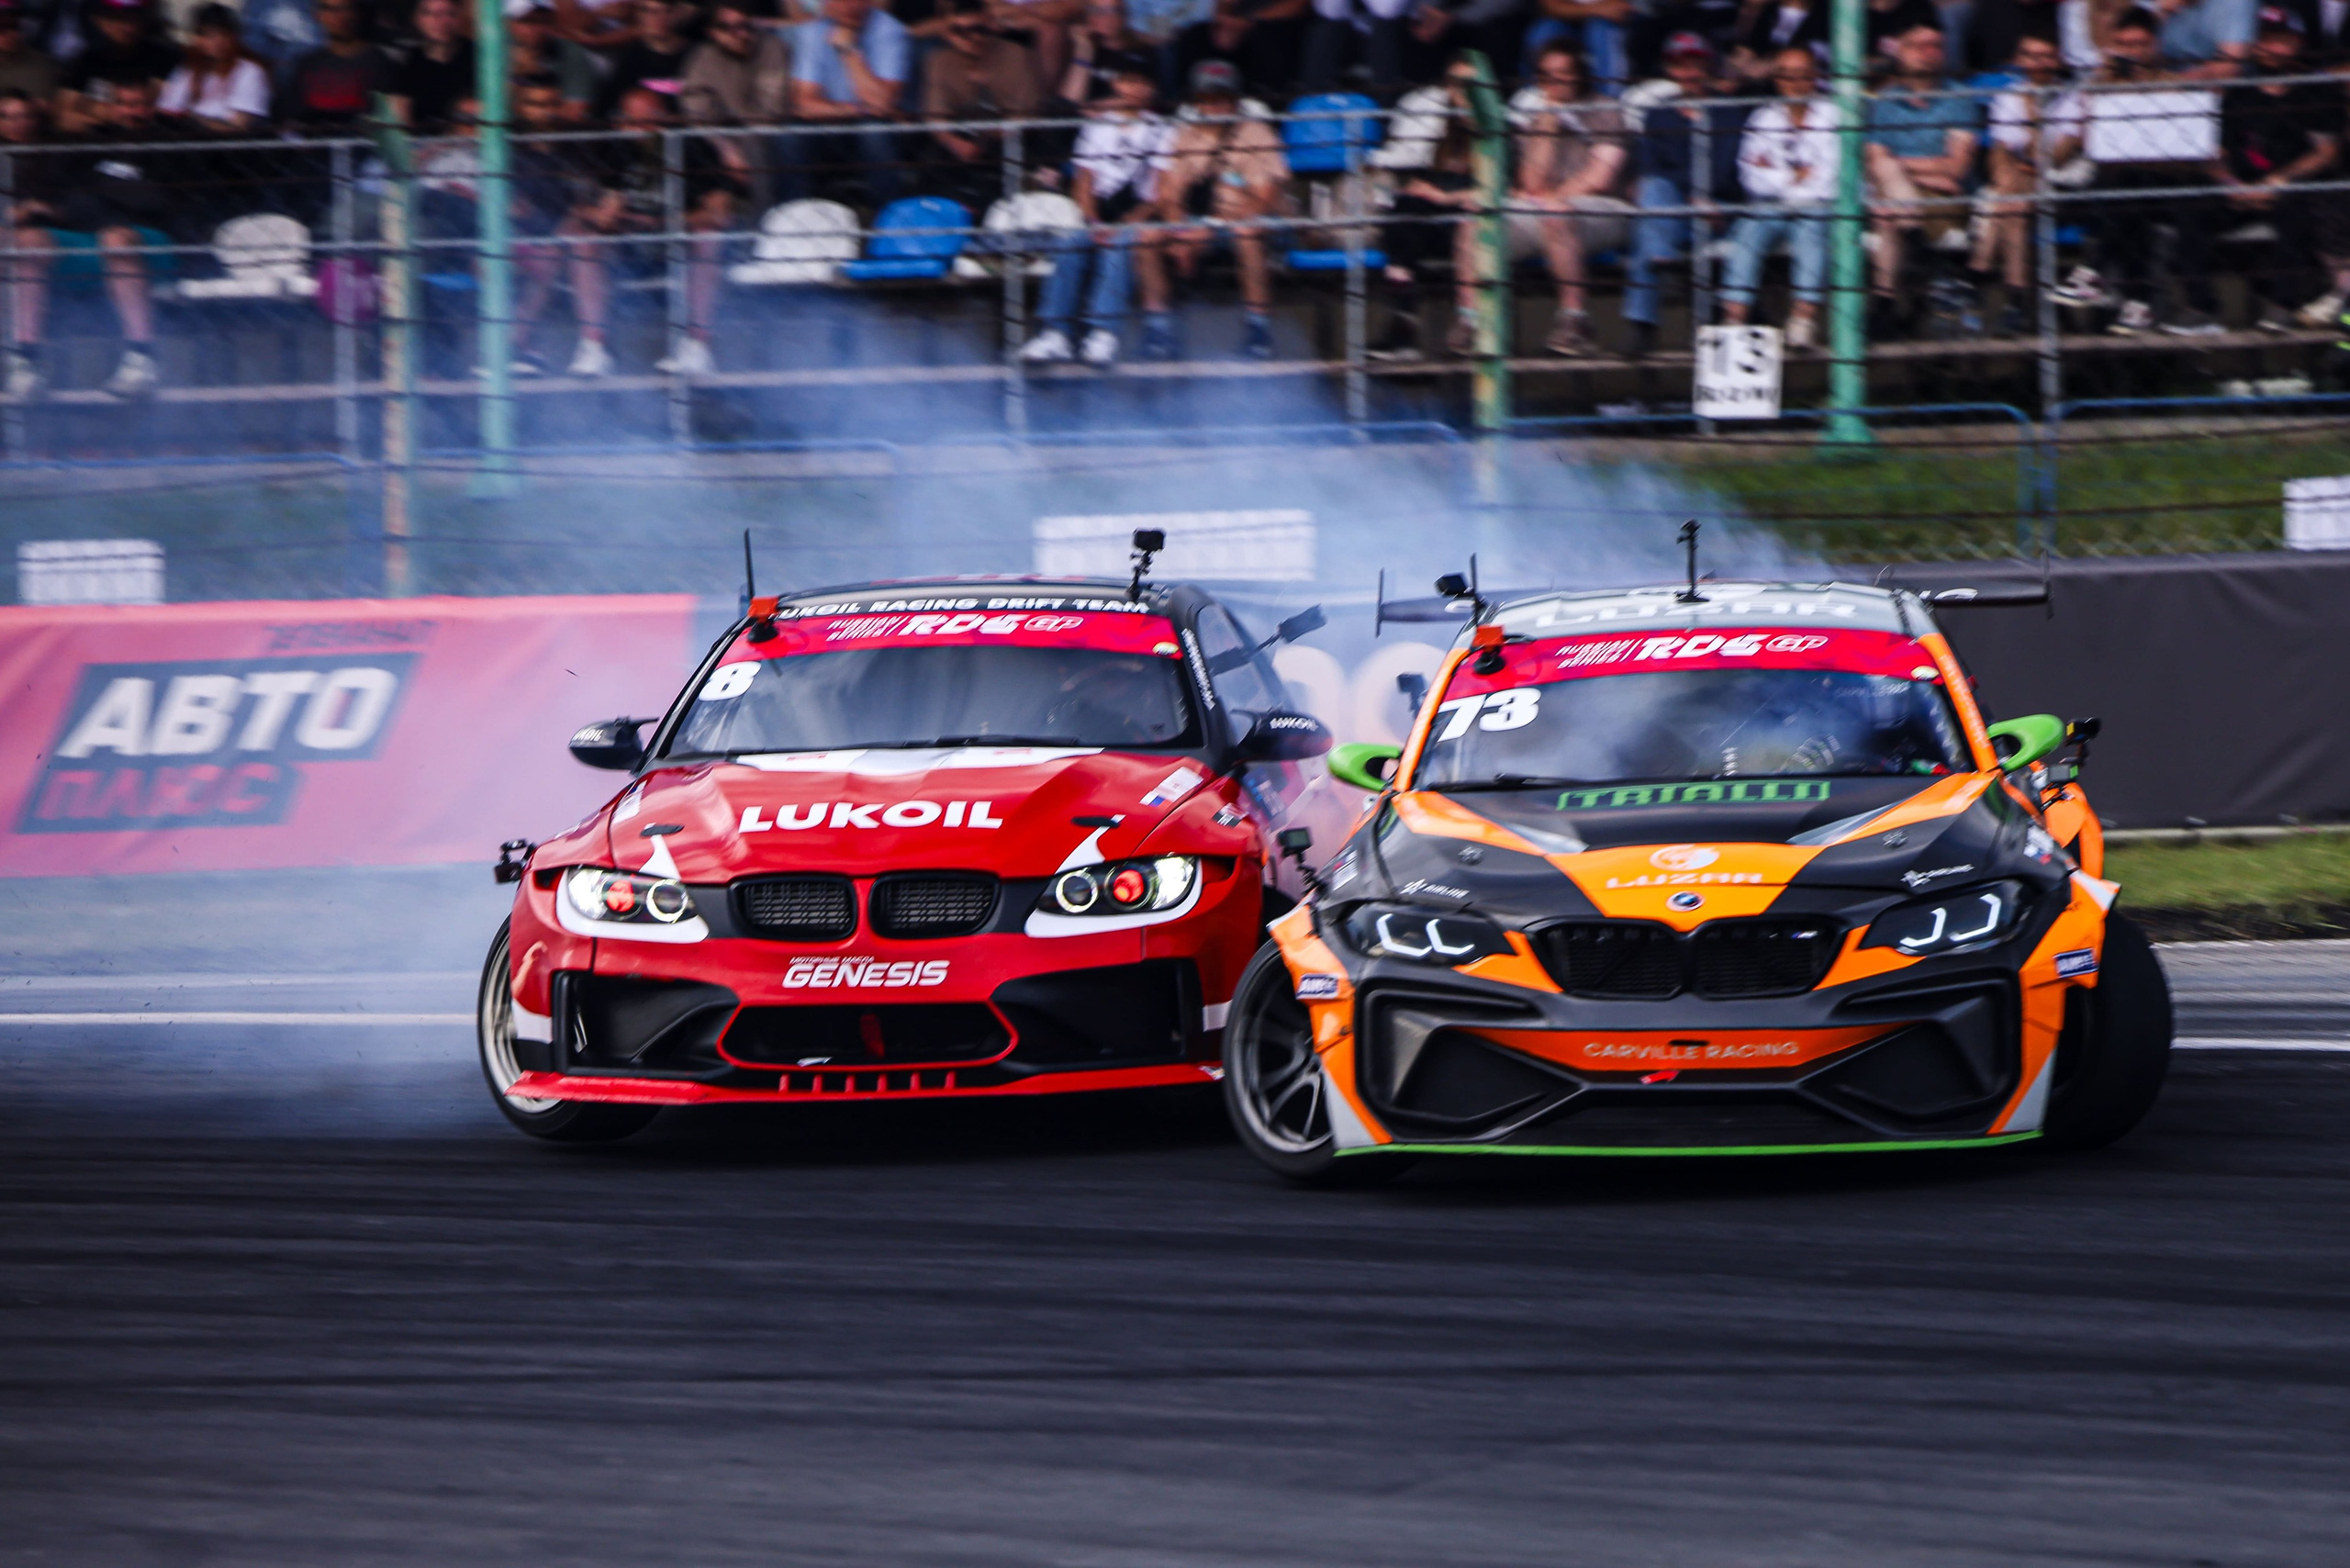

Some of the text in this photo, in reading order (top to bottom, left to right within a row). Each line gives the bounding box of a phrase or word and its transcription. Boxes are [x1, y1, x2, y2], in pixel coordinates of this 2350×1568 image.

[867, 598, 979, 613] RACING
[986, 598, 1067, 610] DRIFT
[1071, 599, 1150, 613] TEAM
[897, 613, 1031, 636] RDS
[1632, 633, 1773, 661] RDS
[698, 660, 762, 701] 8
[54, 667, 398, 758] АВТО
[1437, 687, 1542, 743] 73
[738, 801, 1003, 834] LUKOIL
[1606, 872, 1763, 890] LUZAR
[782, 960, 950, 989] GENESIS
[1583, 1041, 1800, 1059] CARVILLE RACING
